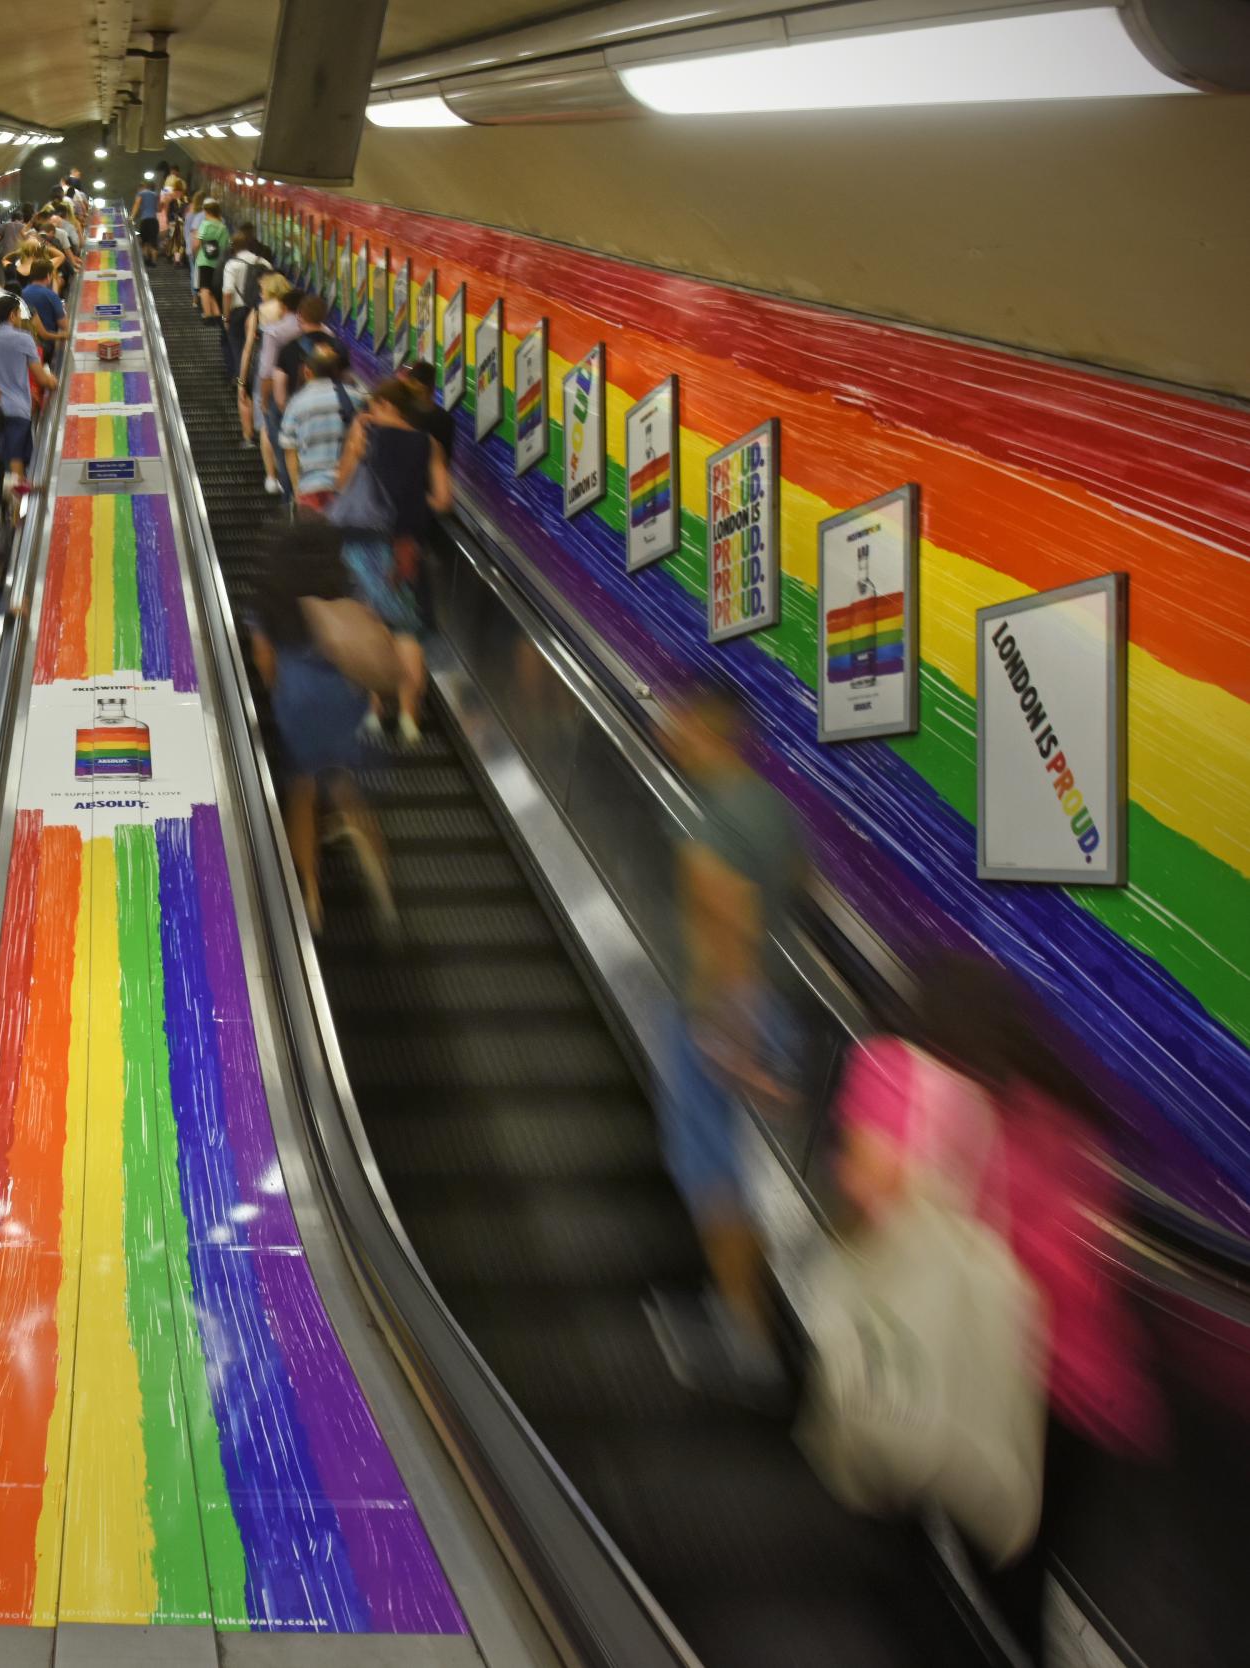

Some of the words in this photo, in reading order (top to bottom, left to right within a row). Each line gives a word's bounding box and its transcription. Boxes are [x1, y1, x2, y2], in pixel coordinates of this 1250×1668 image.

[713, 441, 764, 488] PROUD.
[713, 472, 764, 522] PROUD.
[713, 508, 750, 543] LONDON
[750, 501, 760, 523] IS
[713, 524, 765, 571] PROUD.
[713, 556, 765, 600] PROUD.
[713, 587, 765, 630] PROUD.
[991, 621, 1048, 732] LONDON
[1034, 724, 1058, 760] IS
[1045, 749, 1100, 864] PROUD.
[198, 1610, 329, 1626] drinkaware.co.uk
